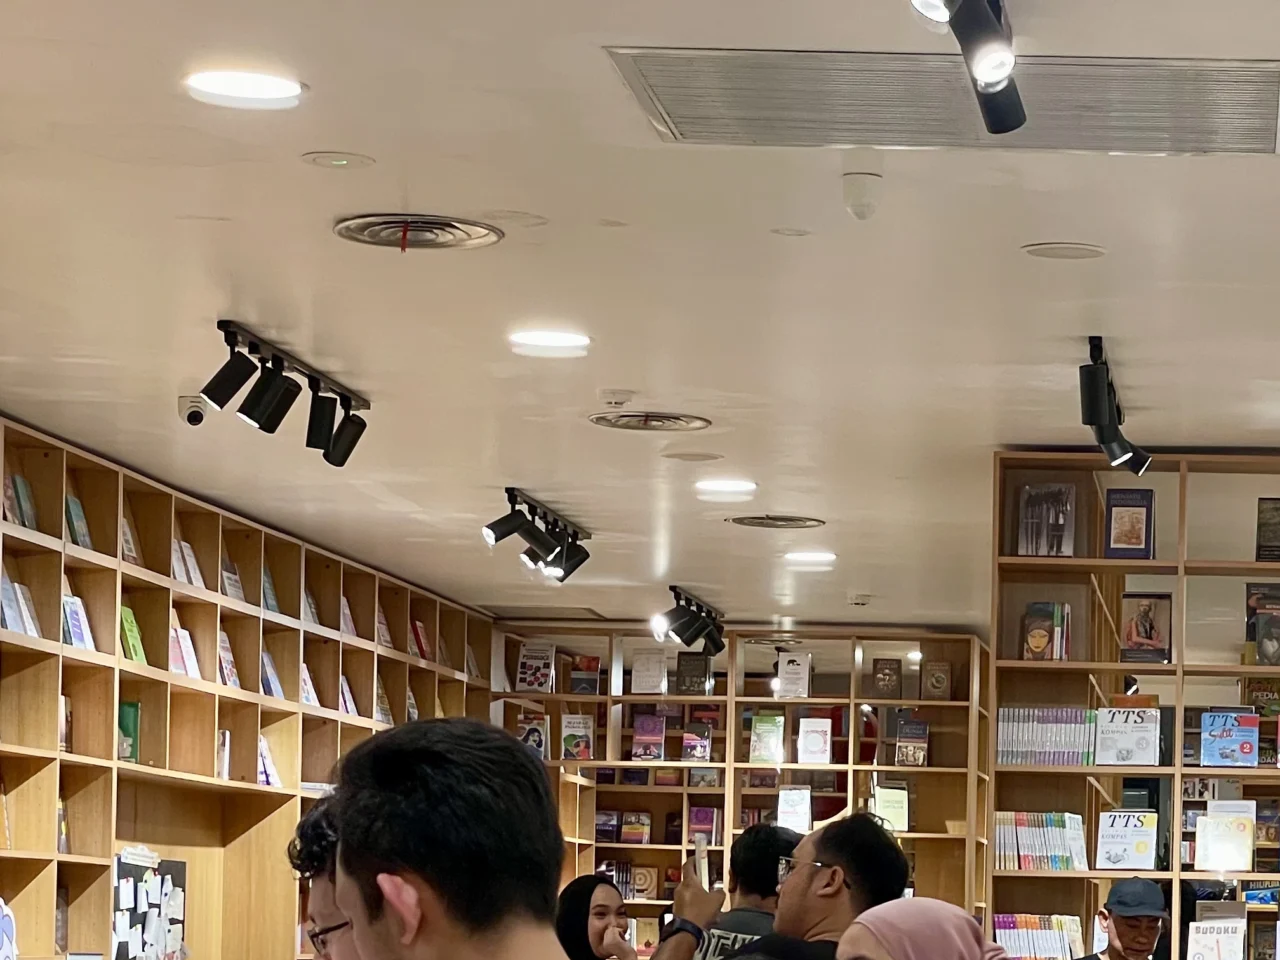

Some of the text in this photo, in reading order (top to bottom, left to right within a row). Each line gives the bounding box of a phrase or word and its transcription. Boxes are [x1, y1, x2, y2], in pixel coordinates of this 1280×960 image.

[1252, 691, 1279, 700] PEDIA
[1108, 710, 1146, 724] TTS
[1209, 714, 1241, 727] TTS
[1243, 743, 1251, 752] 2
[1108, 814, 1147, 828] TTS
[1195, 926, 1238, 935] SUDOKU
